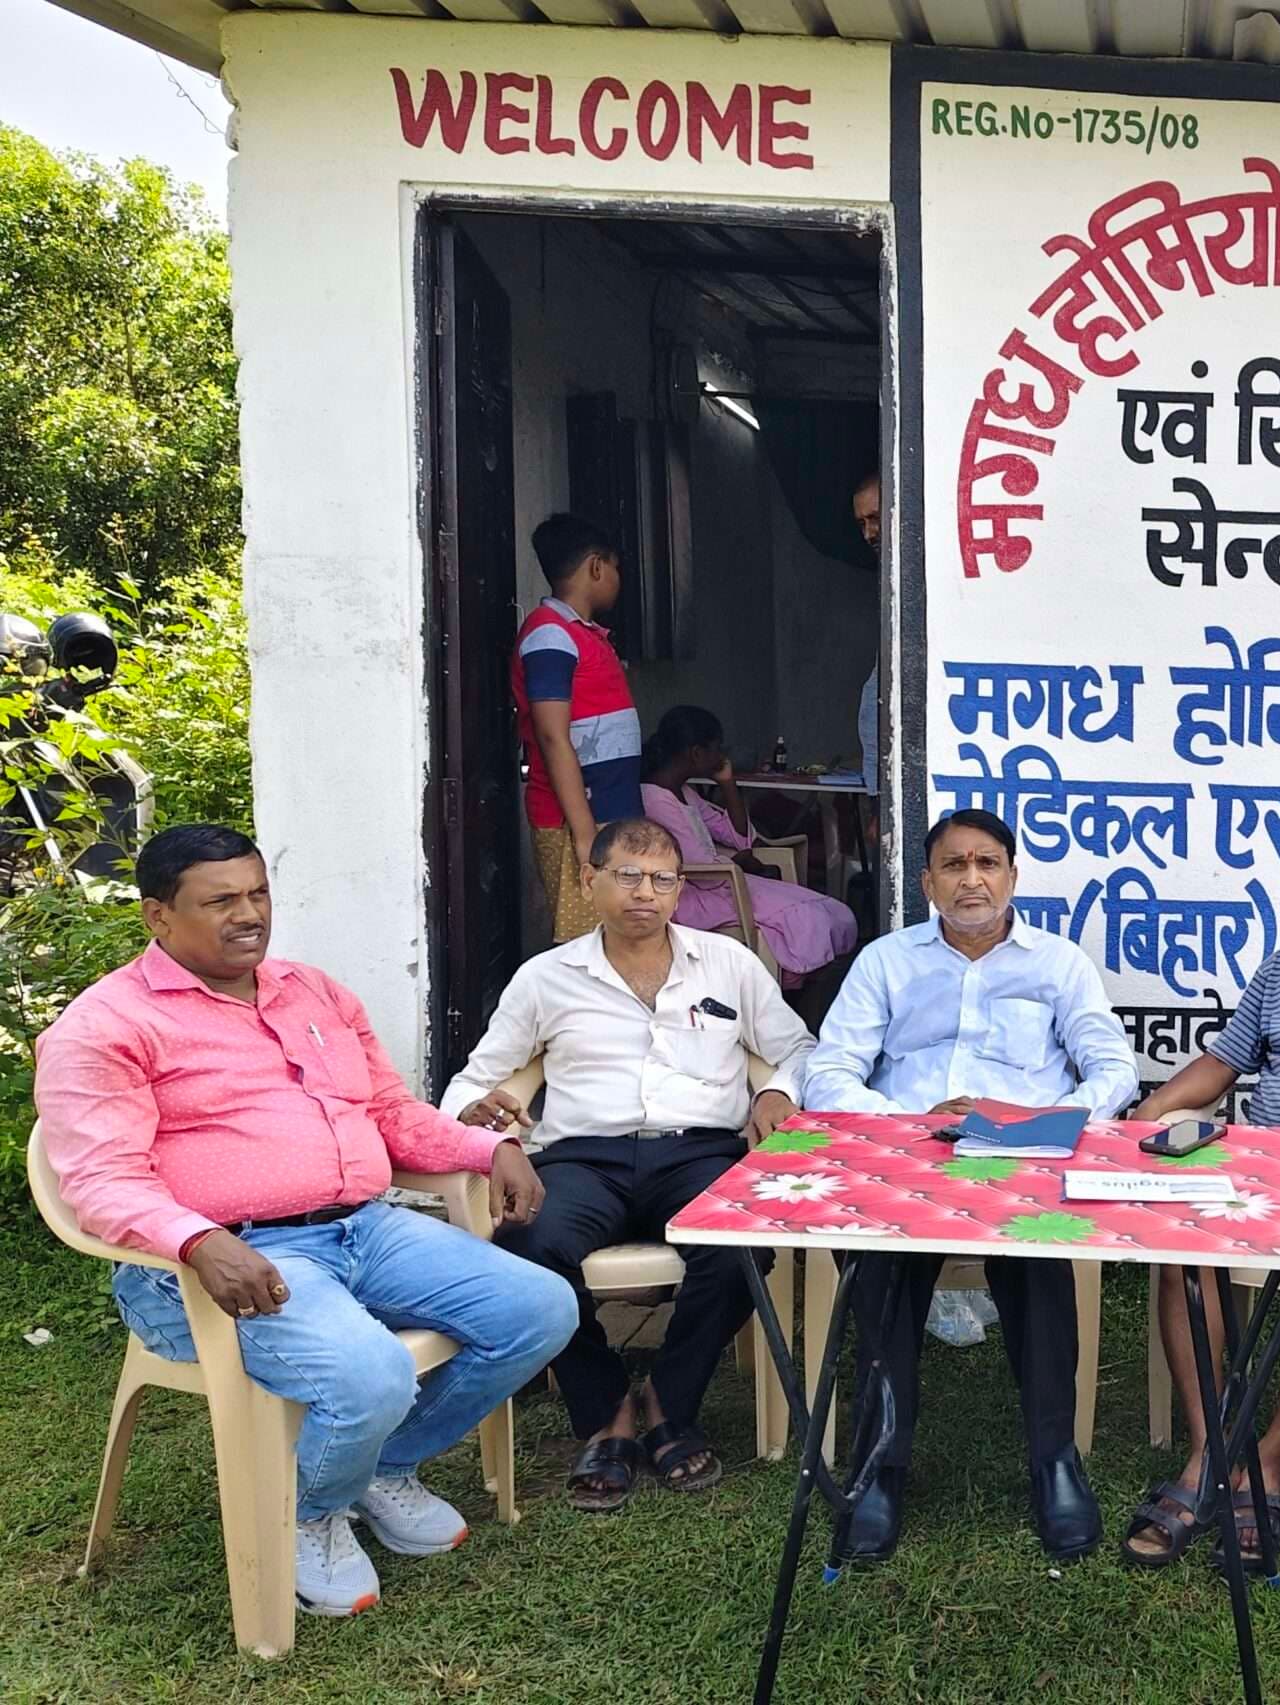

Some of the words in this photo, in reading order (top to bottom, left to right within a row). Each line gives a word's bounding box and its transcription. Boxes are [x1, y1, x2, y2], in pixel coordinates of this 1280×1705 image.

[389, 67, 814, 170] WELCOME
[957, 329, 1084, 579] मगध
[1117, 360, 1214, 465] एवं
[943, 660, 1145, 743] मगध
